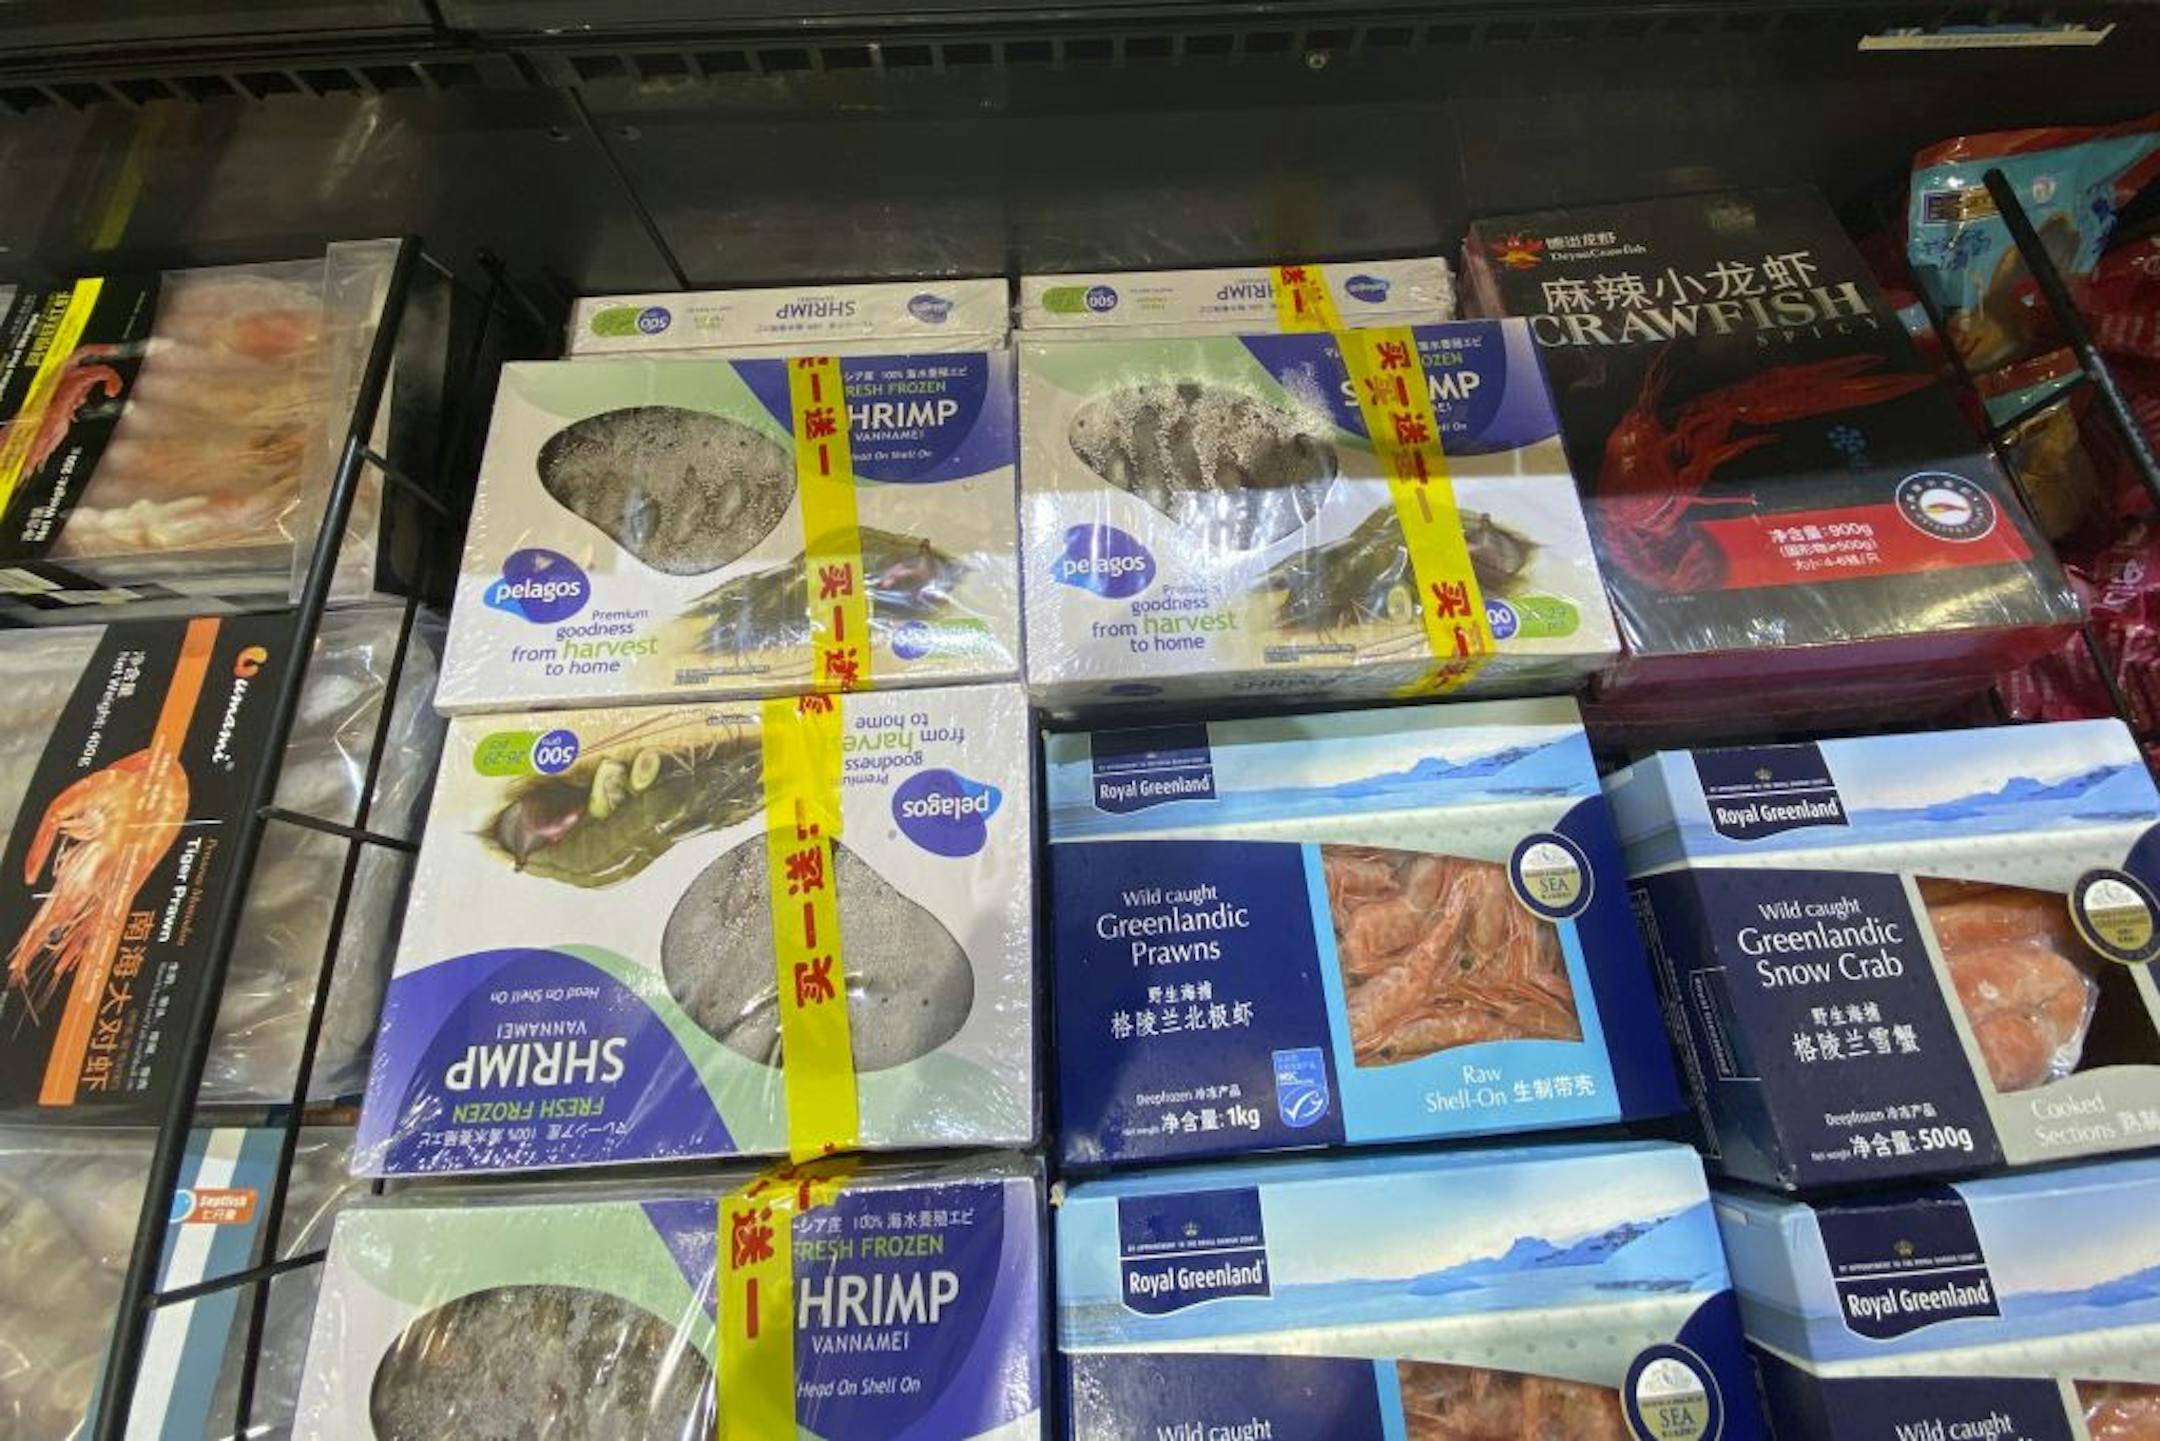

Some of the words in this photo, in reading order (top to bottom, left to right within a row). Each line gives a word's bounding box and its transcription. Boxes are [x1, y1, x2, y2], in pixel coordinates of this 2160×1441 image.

[1217, 278, 1276, 301] HRIMP
[1541, 250, 1820, 314] 麻辣小龙虾
[776, 300, 856, 319] SHRIMP
[1528, 281, 1872, 347] CRAWFISH
[1421, 351, 1464, 367] OZEN
[845, 384, 883, 398] RESH
[888, 381, 946, 397] FROZEN
[849, 400, 959, 431] HRIMP
[496, 577, 582, 605] pelagos
[592, 608, 649, 621] Premium
[1131, 596, 1209, 617] goodness
[1486, 608, 1512, 627] 00
[556, 622, 635, 642] goodness
[1092, 621, 1138, 639] from
[1142, 611, 1239, 636] harvest
[511, 646, 557, 663] from
[563, 637, 659, 660] harvest
[1130, 637, 1149, 653] to
[1153, 634, 1206, 652] home
[545, 662, 563, 677] to
[569, 659, 621, 675] home
[855, 713, 904, 731] home
[910, 712, 930, 726] to
[843, 731, 914, 753] harve
[920, 727, 966, 744] from
[536, 746, 573, 765] 500
[845, 751, 923, 771] goodness
[1099, 779, 1138, 803] Royal
[1140, 774, 1211, 798] Greenland
[902, 790, 989, 821] pelagos
[1716, 802, 1761, 829] Royal
[1760, 796, 1840, 823] Greenland
[178, 837, 202, 882] Tiger
[1121, 889, 1162, 908] Wild
[1166, 883, 1218, 905] caught
[1539, 877, 1569, 893] SEA
[157, 885, 188, 943] Prawn
[1758, 901, 1803, 921] Wild
[1804, 895, 1862, 921] caught
[1096, 902, 1251, 940] Greenlandic
[1737, 916, 1904, 956] Greenlandic
[1131, 940, 1222, 967] Prawns
[1755, 958, 1831, 988] Snow
[1838, 949, 1905, 982] Crab
[82, 911, 156, 1092] 南海大对虾
[509, 988, 542, 1002] Shell
[545, 987, 564, 1000] On
[566, 985, 600, 999] Head
[496, 1019, 588, 1038] VANNAMEI
[1110, 1001, 1255, 1040] 格陵兰北极虾
[1792, 1024, 1921, 1063] 格陵兰雪蟹
[445, 1036, 628, 1091] SHRIMP
[1462, 1064, 1502, 1085] Raw
[1424, 1087, 1507, 1114] Shell-On
[1512, 1073, 1597, 1104] 生制带壳
[2031, 1088, 2106, 1119] Cooked
[453, 1100, 533, 1123] FROZEN
[540, 1096, 604, 1120] FRESH
[1849, 1126, 1974, 1160] 净含量:500g
[862, 1234, 945, 1259] FROZEN
[1130, 1266, 1175, 1299] Royal
[1178, 1258, 1263, 1291] Greenland
[798, 1270, 960, 1330] HRIMP
[1847, 1286, 1899, 1322] Royal
[1899, 1278, 1991, 1313] Greenland
[811, 1331, 911, 1354] VANNAMEI
[796, 1380, 835, 1399] Head
[837, 1379, 858, 1396] On
[860, 1377, 898, 1395] Shell
[900, 1376, 921, 1393] On
[1156, 1420, 1203, 1441] Wild
[1208, 1416, 1273, 1441] caught
[1658, 1406, 1695, 1427] SEA
[1895, 1416, 1945, 1441] Wild
[1949, 1411, 2014, 1441] caught
